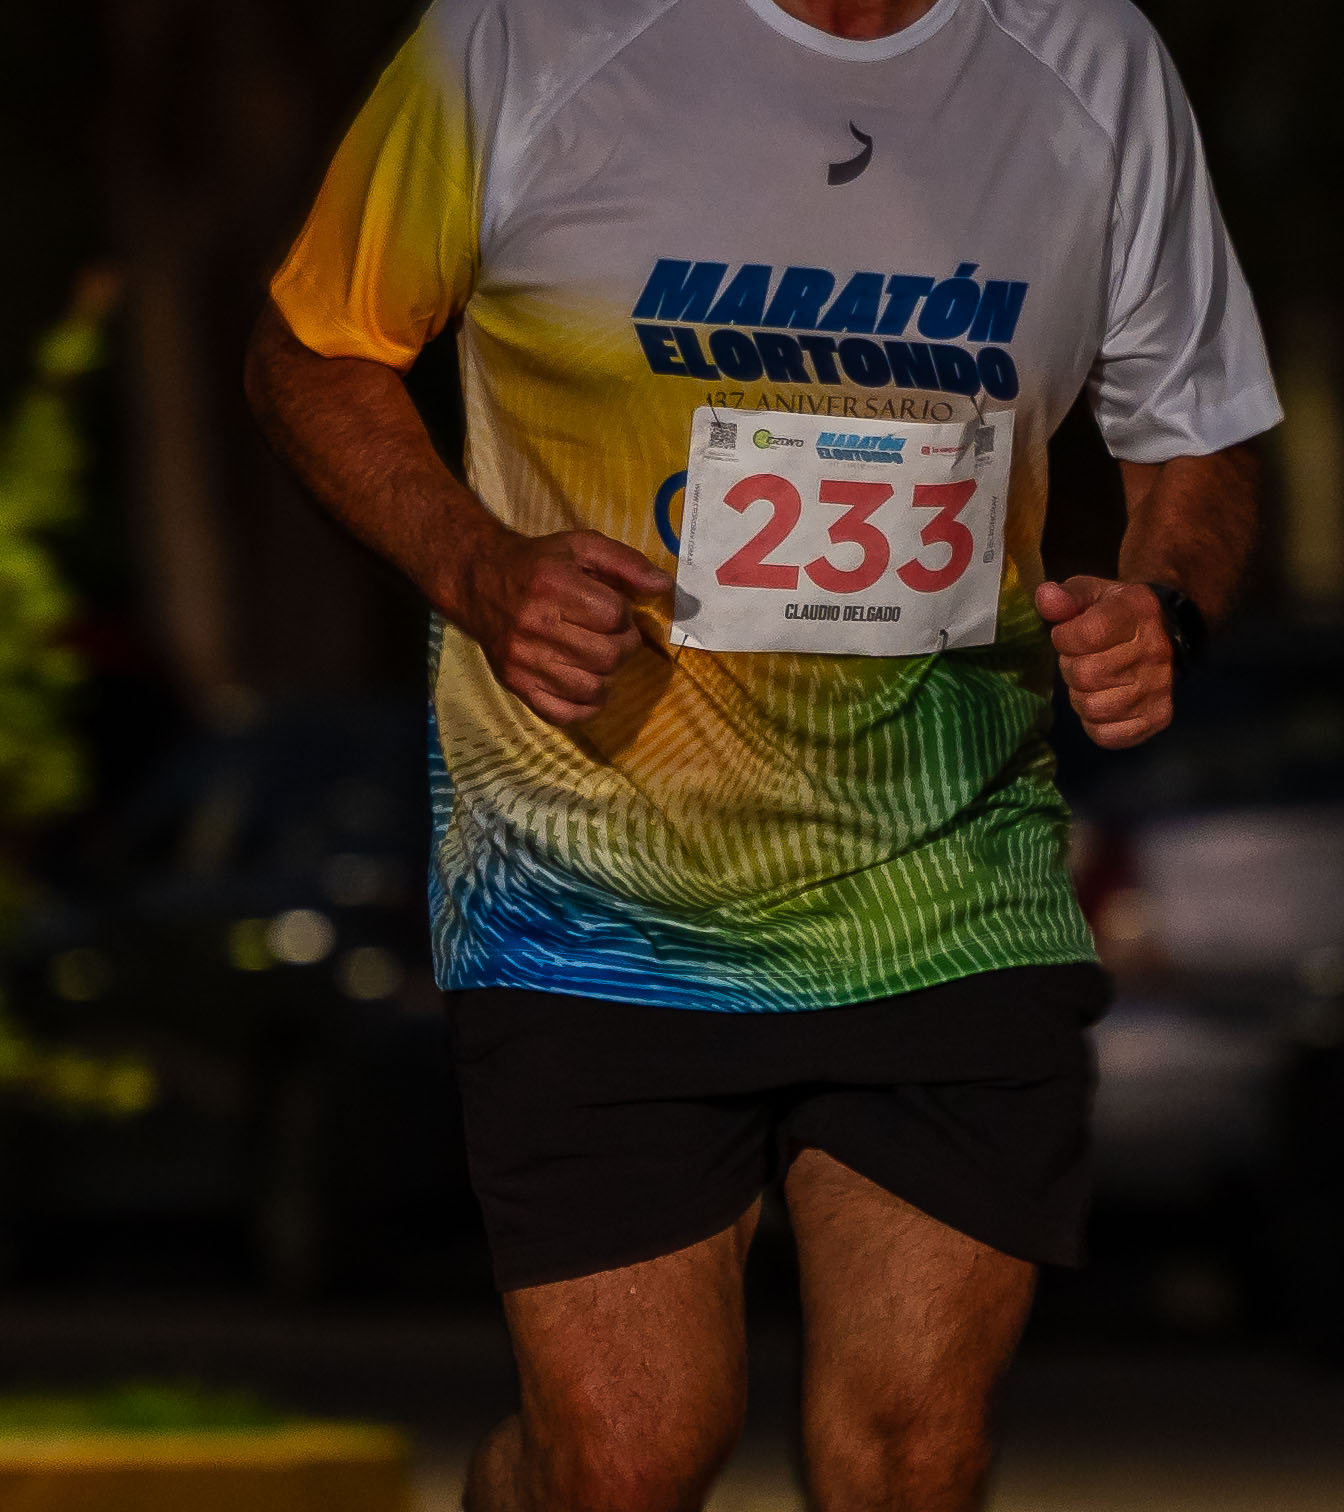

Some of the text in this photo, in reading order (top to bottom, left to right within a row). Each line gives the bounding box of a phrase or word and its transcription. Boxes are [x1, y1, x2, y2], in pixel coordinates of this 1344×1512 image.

[631, 258, 1028, 342] MARATÓN
[633, 322, 1018, 401] ELORTONDO
[706, 391, 954, 422] 137 ANIVERSARIO
[816, 432, 907, 451] MARATÓN
[816, 448, 904, 464] ELORTONDO
[716, 473, 977, 593] 233
[784, 603, 901, 624] CLAUDIO DELGADO
